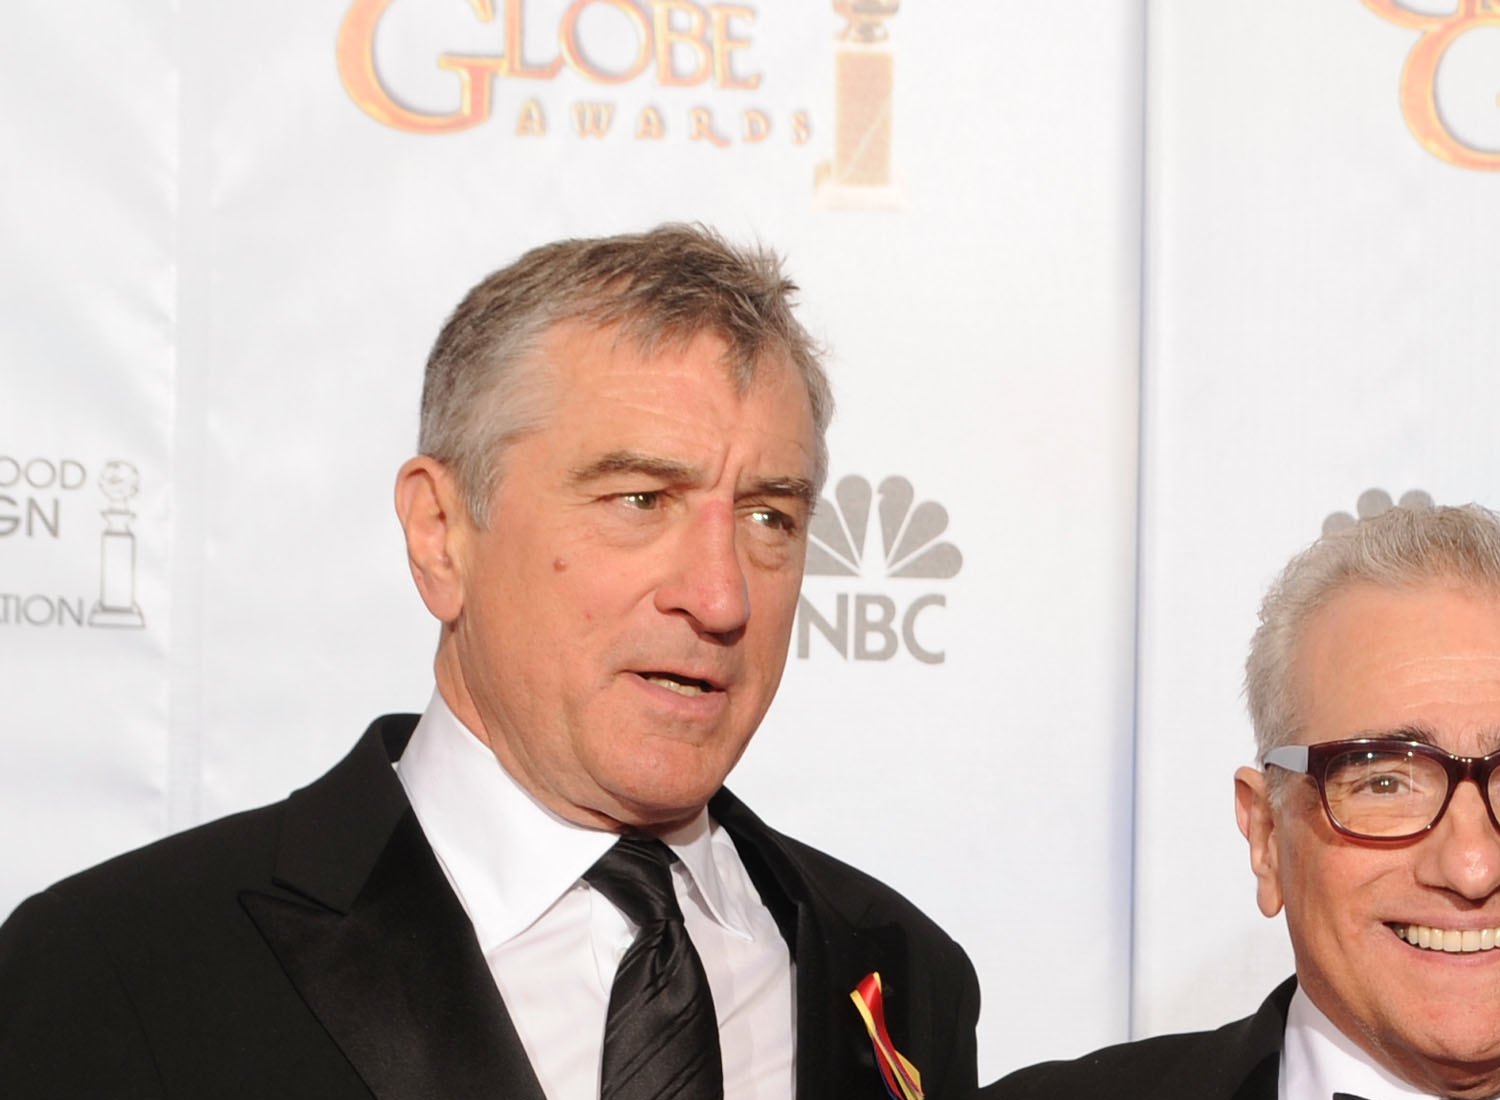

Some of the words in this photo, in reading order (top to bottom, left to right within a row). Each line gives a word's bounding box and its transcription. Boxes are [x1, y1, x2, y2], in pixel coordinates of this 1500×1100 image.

[336, 0, 763, 136] GLOBE
[515, 98, 813, 148] AWARDS
[0, 593, 84, 627] TION
[796, 592, 947, 665] NBC
